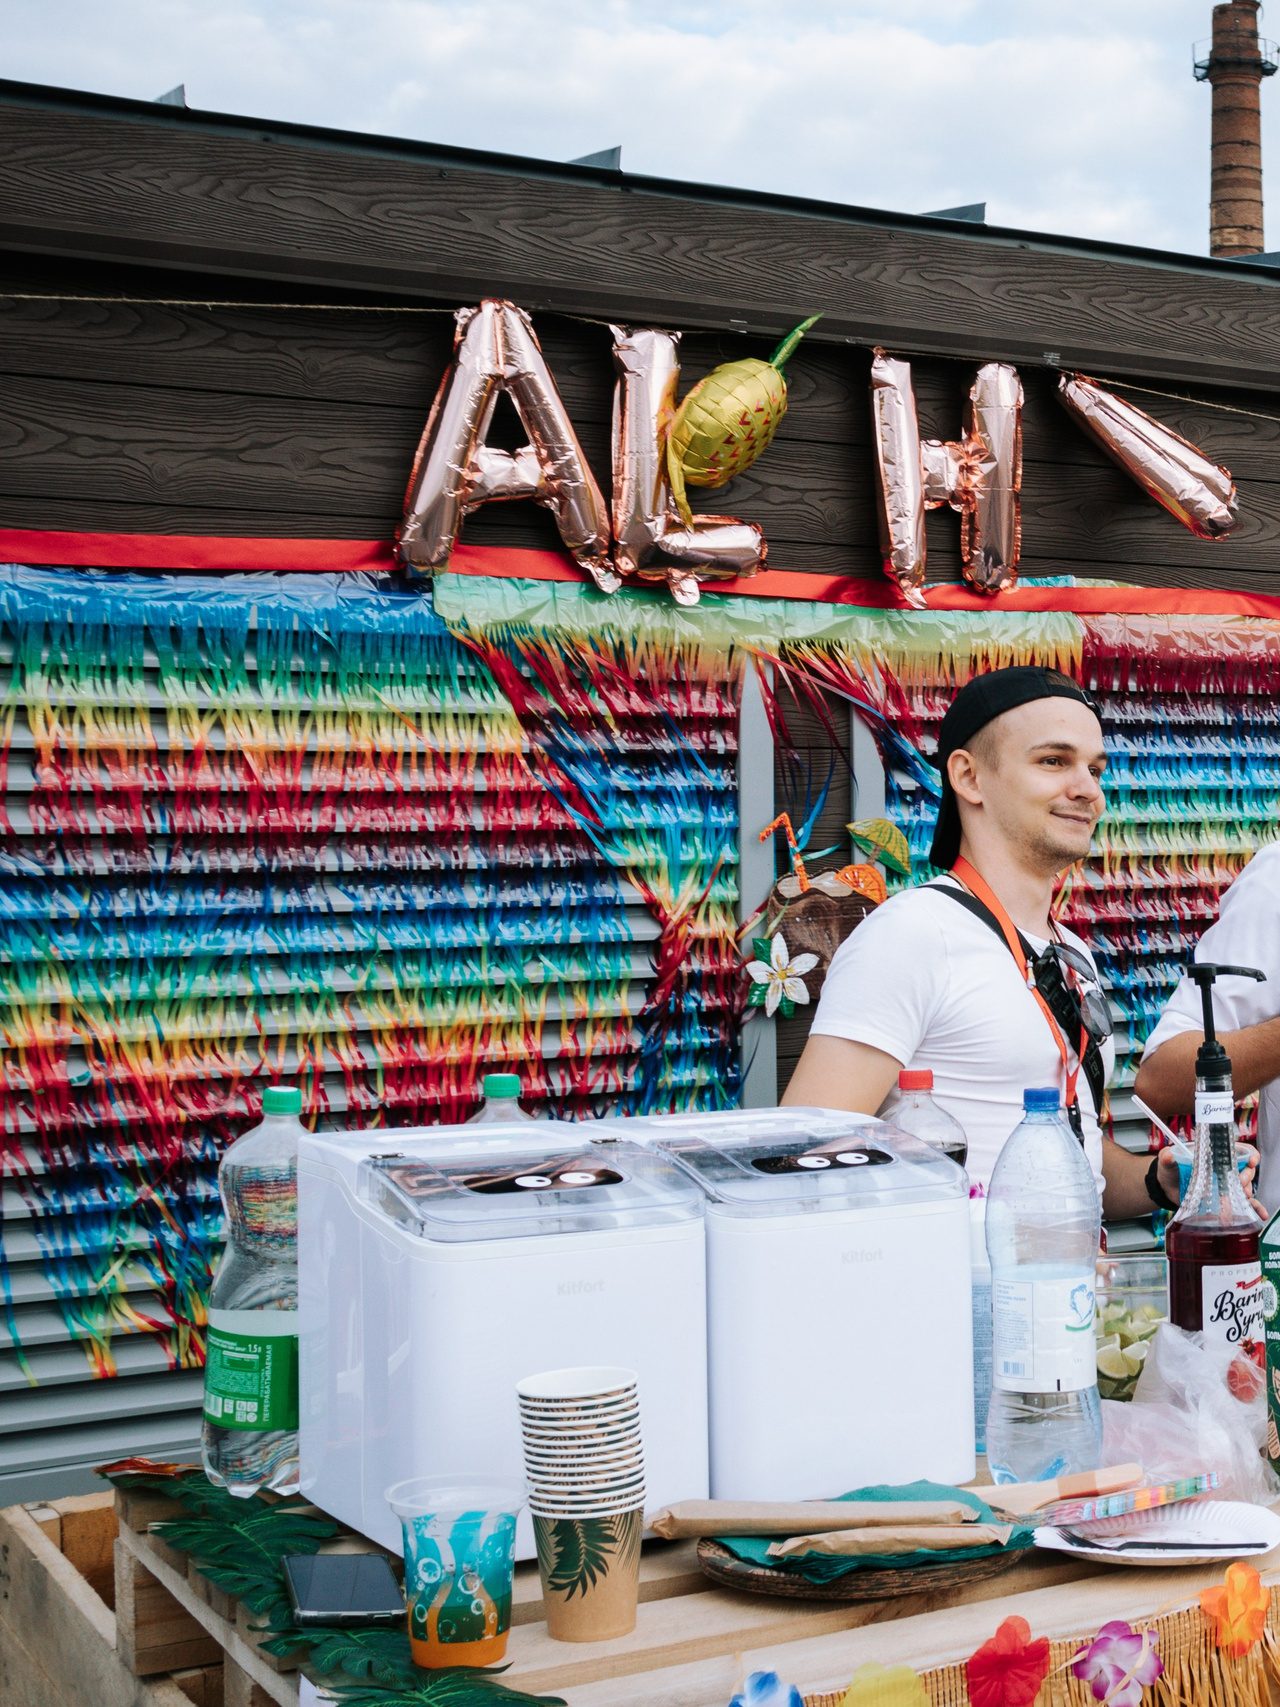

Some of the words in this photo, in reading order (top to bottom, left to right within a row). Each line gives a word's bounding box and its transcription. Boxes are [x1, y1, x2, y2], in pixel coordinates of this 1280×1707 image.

[841, 1247, 884, 1264] Kitfort
[557, 1279, 605, 1296] Kitfort
[263, 1344, 273, 1422] ПЕРЕРАБАТЫВАЕМАЯ
